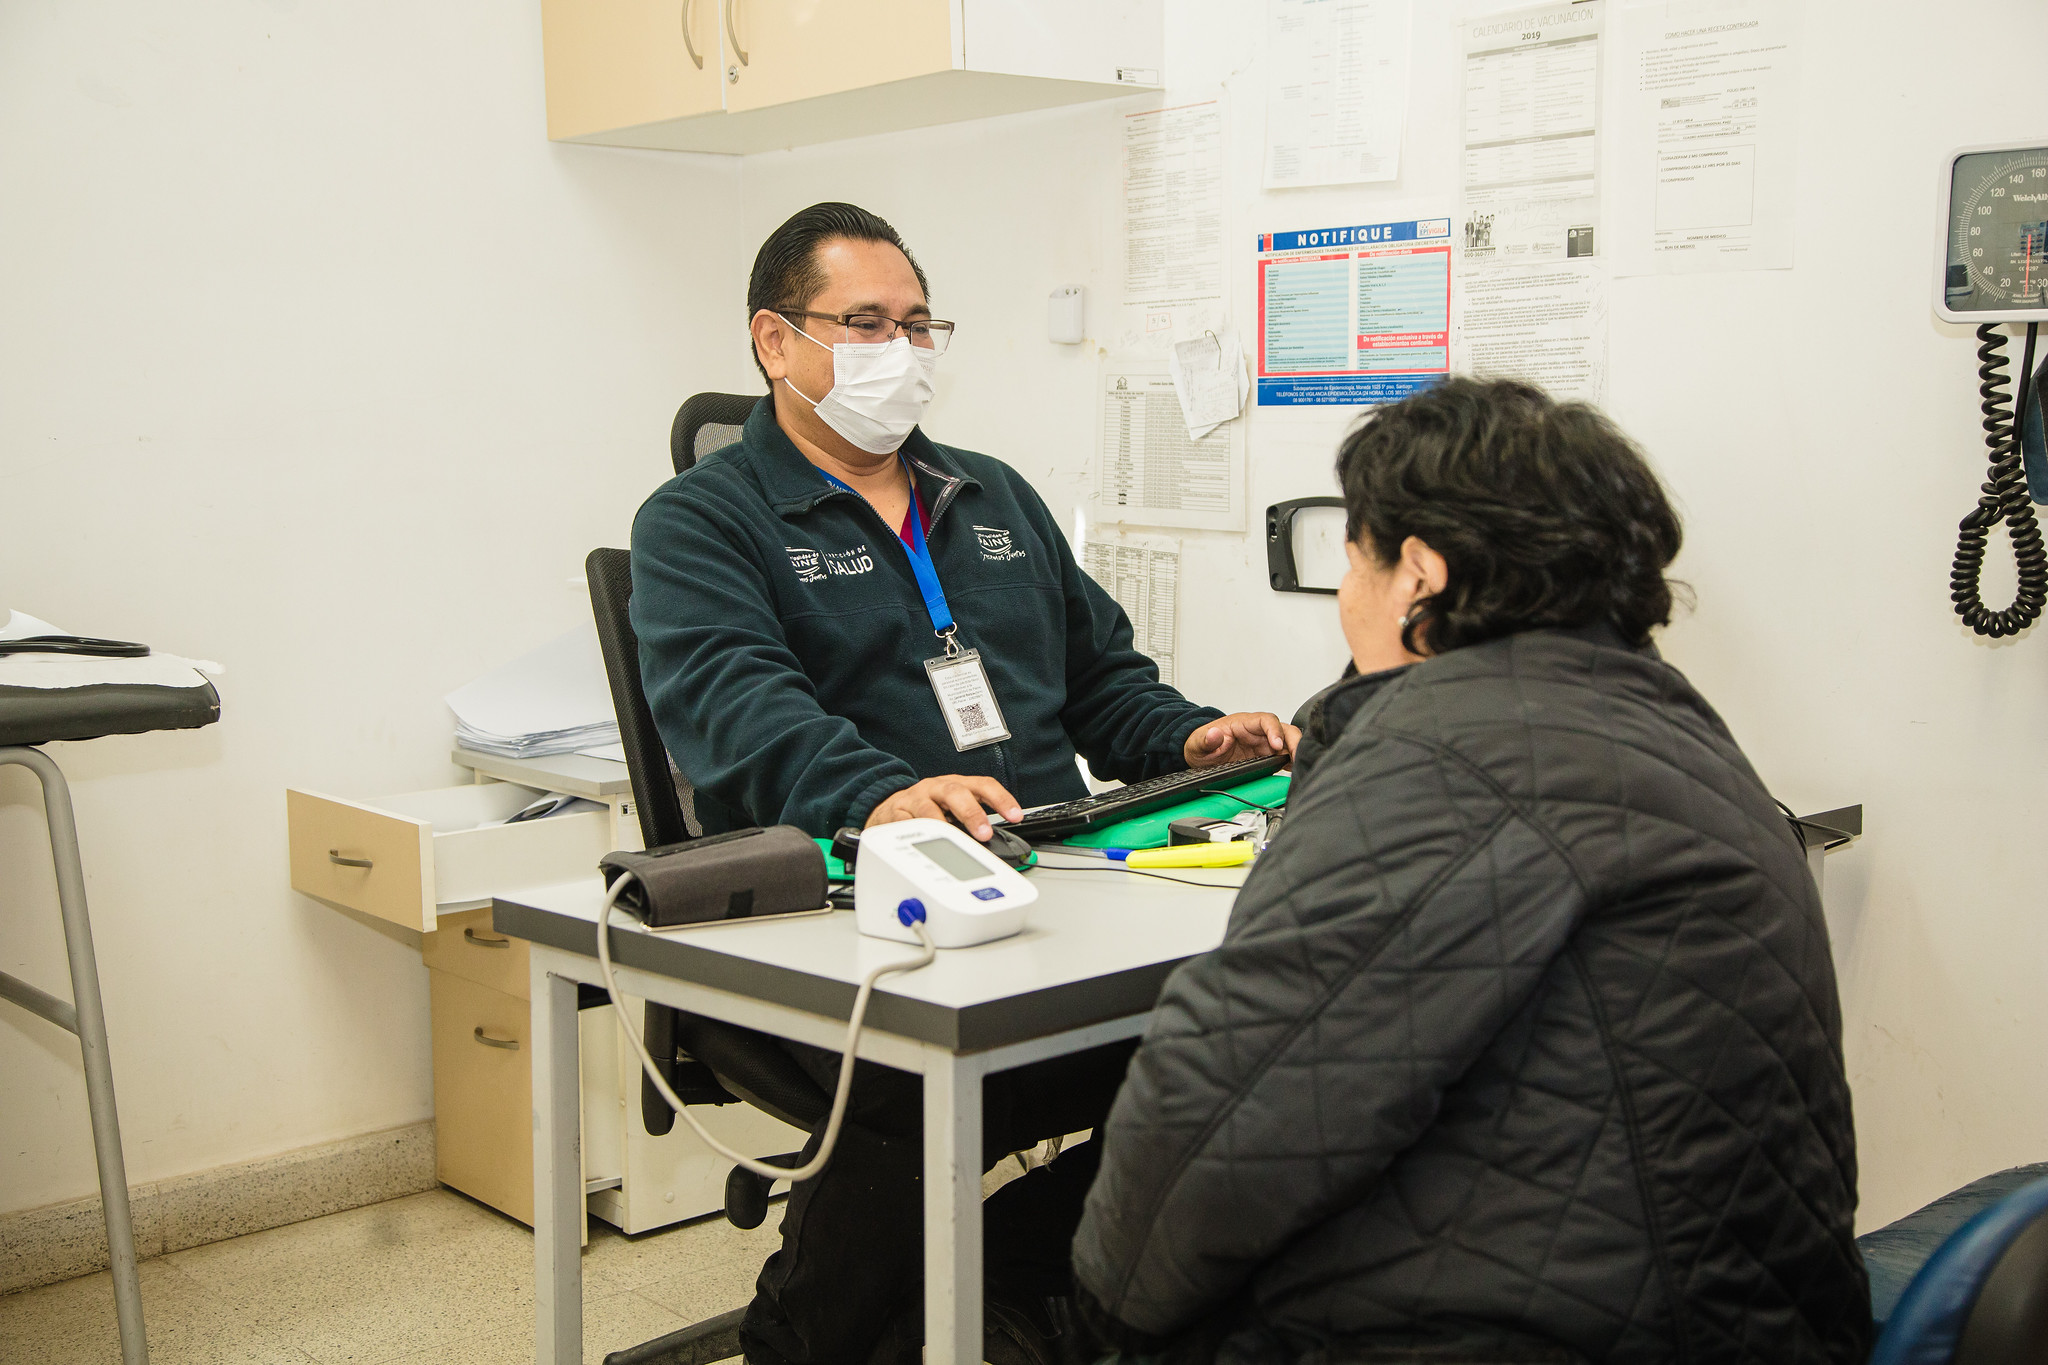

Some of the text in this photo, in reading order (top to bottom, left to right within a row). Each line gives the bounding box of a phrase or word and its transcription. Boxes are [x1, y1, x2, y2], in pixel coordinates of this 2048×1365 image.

[1473, 9, 1593, 37] CALENDARIO DE VACUNACIÓN
[1522, 31, 1540, 40] 2019
[2032, 168, 2046, 178] 160
[2009, 174, 2024, 184] 140
[1990, 188, 2005, 197] 120
[1977, 206, 1992, 215] 100
[1970, 226, 1980, 236] 80
[1298, 227, 1392, 246] NOTIFIQUE
[1972, 248, 1983, 257] 60
[1983, 266, 1993, 276] 40
[2000, 278, 2010, 287] 20
[2038, 278, 2048, 287] 30
[828, 555, 874, 576] SALUD
